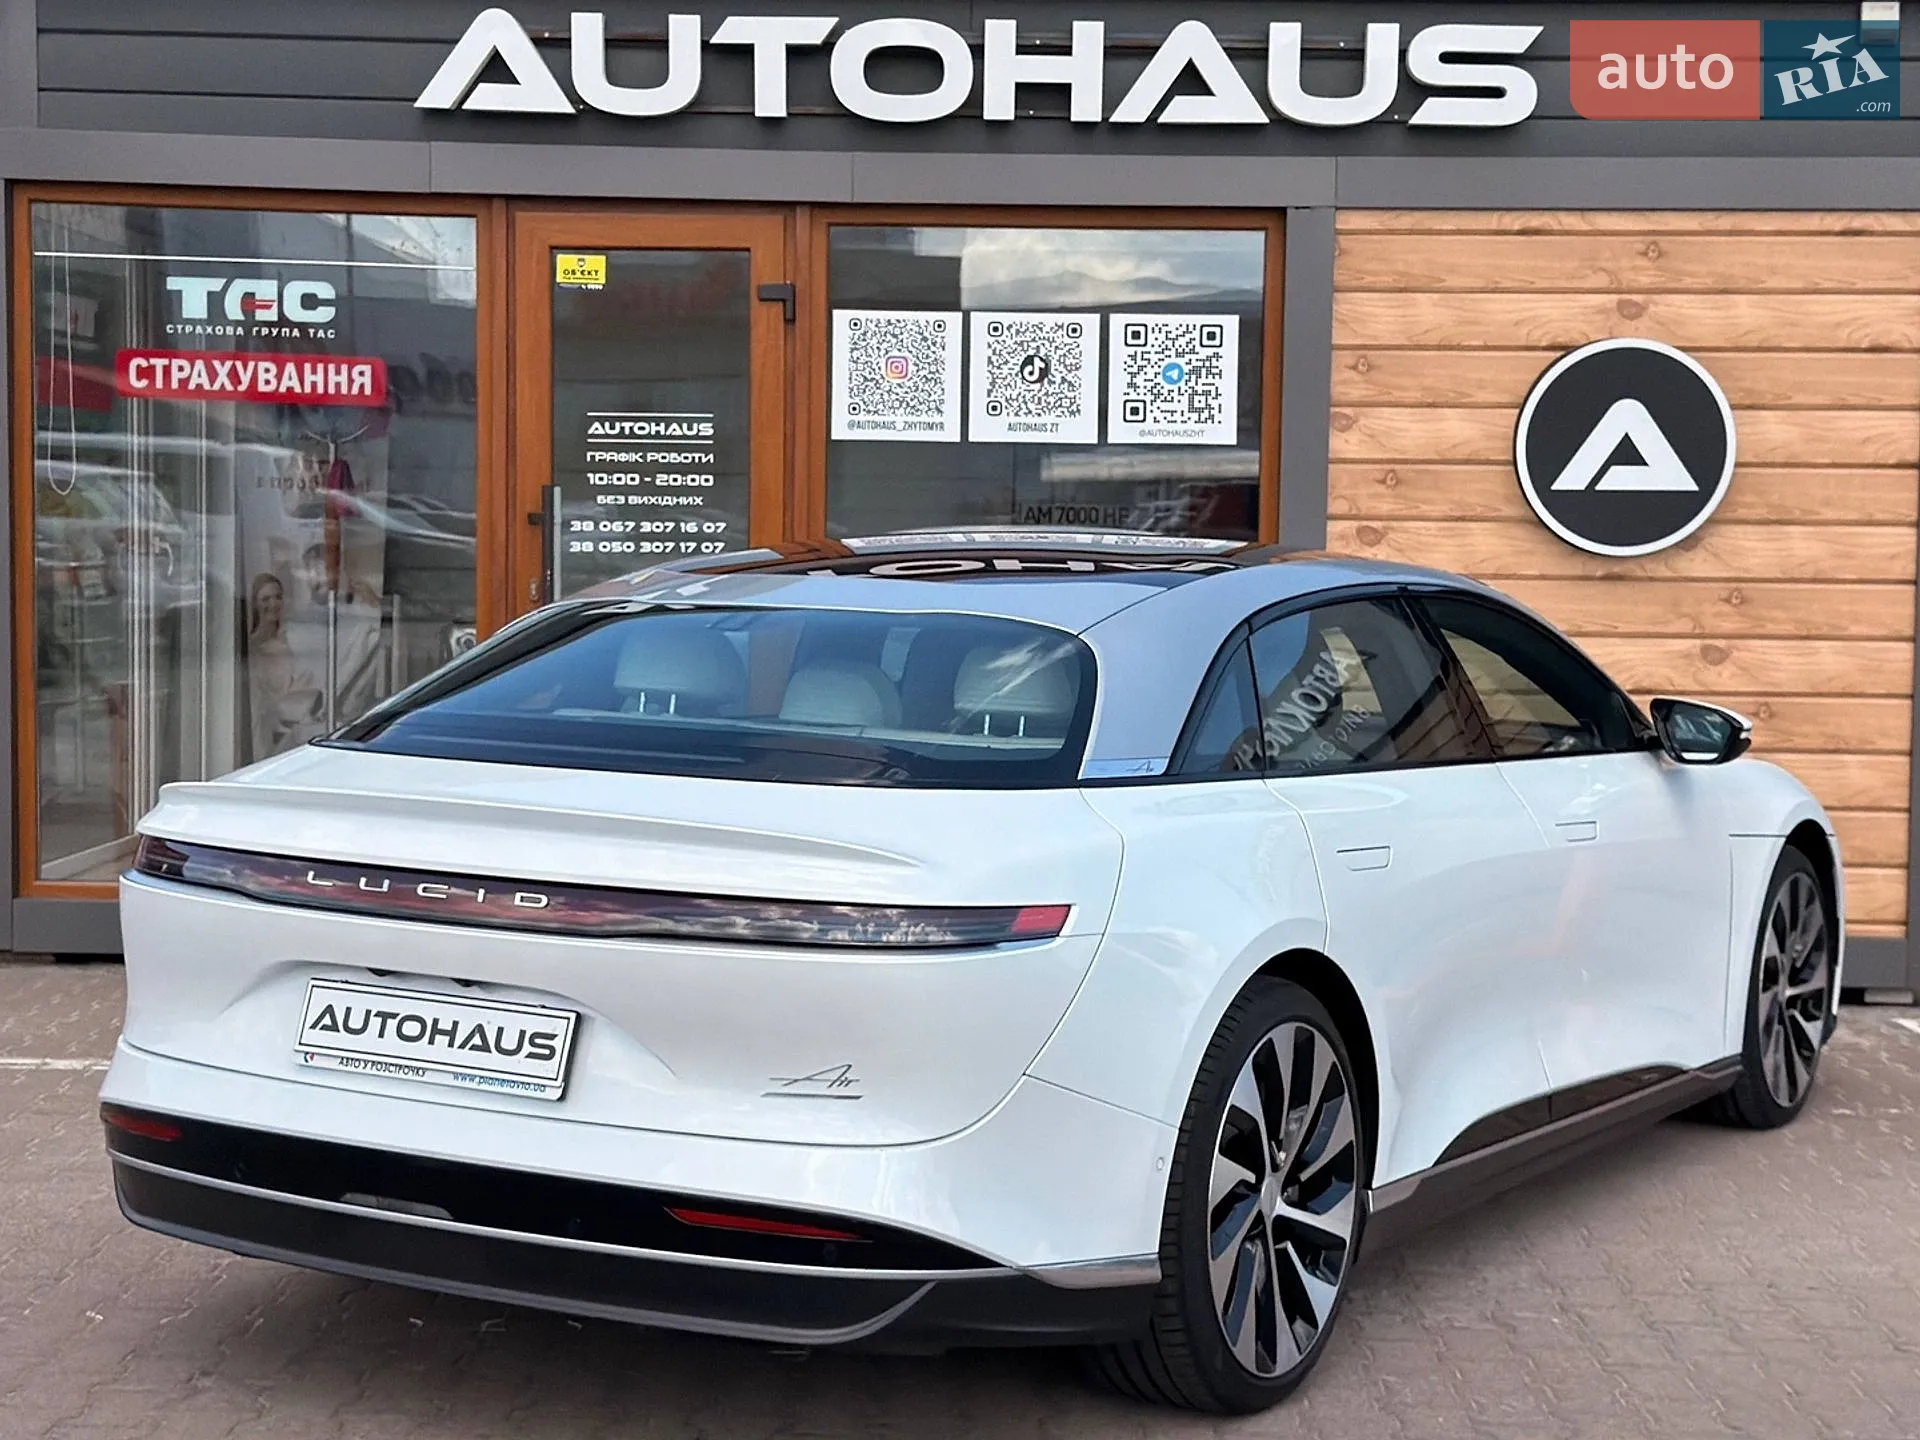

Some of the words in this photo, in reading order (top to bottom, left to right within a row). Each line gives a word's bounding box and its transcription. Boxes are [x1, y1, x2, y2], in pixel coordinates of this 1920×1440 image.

[413, 7, 1543, 127] AUTOHAUS
[166, 323, 244, 337] СТРАХОВА
[252, 326, 300, 338] ГРУПА
[309, 329, 336, 339] ТАС
[129, 357, 372, 396] СТРАХУВАННЯ
[587, 421, 714, 436] AUTOHAUS
[1007, 421, 1048, 433] AUTOHAUS
[586, 451, 643, 463] ГРАФІК
[647, 452, 714, 464] РОБОТИ
[586, 473, 640, 485] 10:00
[655, 473, 714, 486] 20:00
[597, 495, 625, 505] БЕЗ
[628, 496, 703, 506] ВИХІДНИХ
[1055, 506, 1099, 524] 7000
[570, 520, 594, 532] 38
[599, 521, 636, 532] 067
[640, 521, 676, 533] 307
[680, 522, 698, 533] 16
[703, 522, 727, 533] 07
[569, 541, 594, 552] 38
[598, 541, 636, 553] 050
[640, 542, 676, 553] 307
[679, 542, 697, 553] 17
[701, 542, 726, 554] 07
[307, 870, 550, 909] LUCID
[309, 1003, 559, 1062] AUTOHAUS
